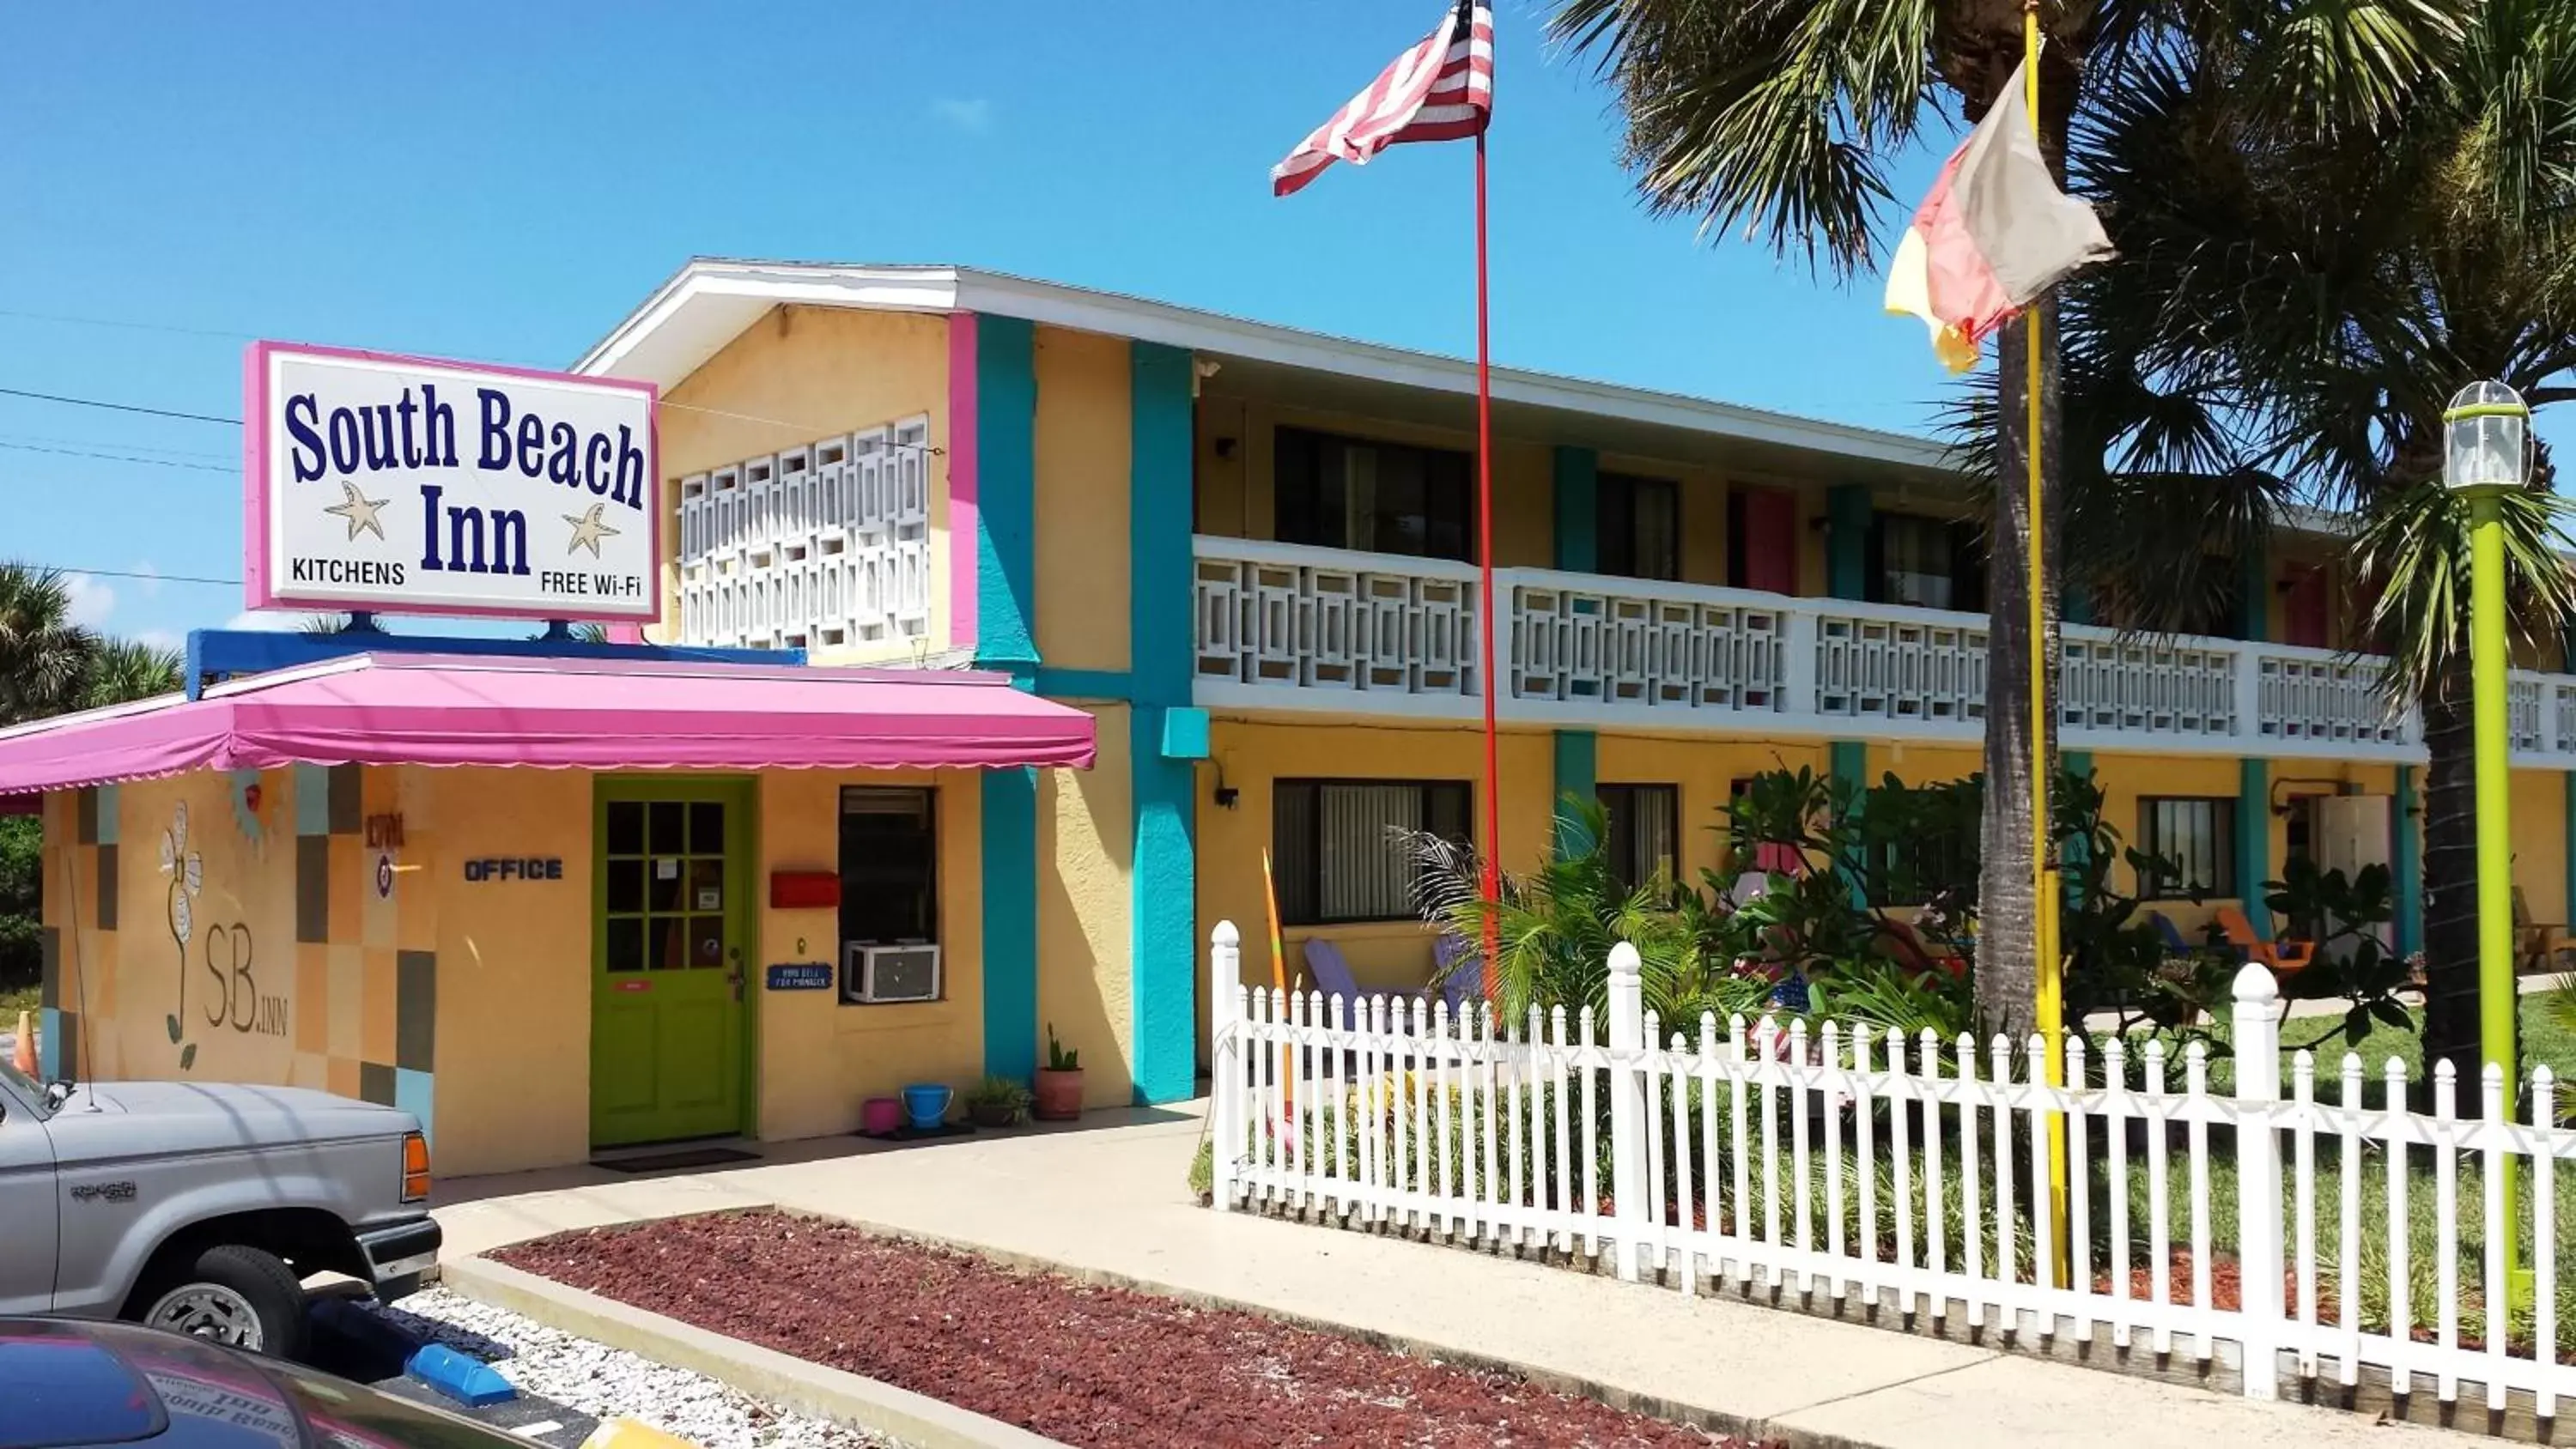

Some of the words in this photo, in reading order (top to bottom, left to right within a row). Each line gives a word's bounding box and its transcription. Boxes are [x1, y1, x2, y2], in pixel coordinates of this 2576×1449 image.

[285, 384, 459, 483] South
[477, 387, 645, 511] Beach
[420, 484, 531, 576] Inn
[292, 558, 405, 585] KITCHENS
[541, 571, 588, 595] FREE
[593, 574, 642, 597] Wi-Fi
[464, 858, 563, 882] OFFICE
